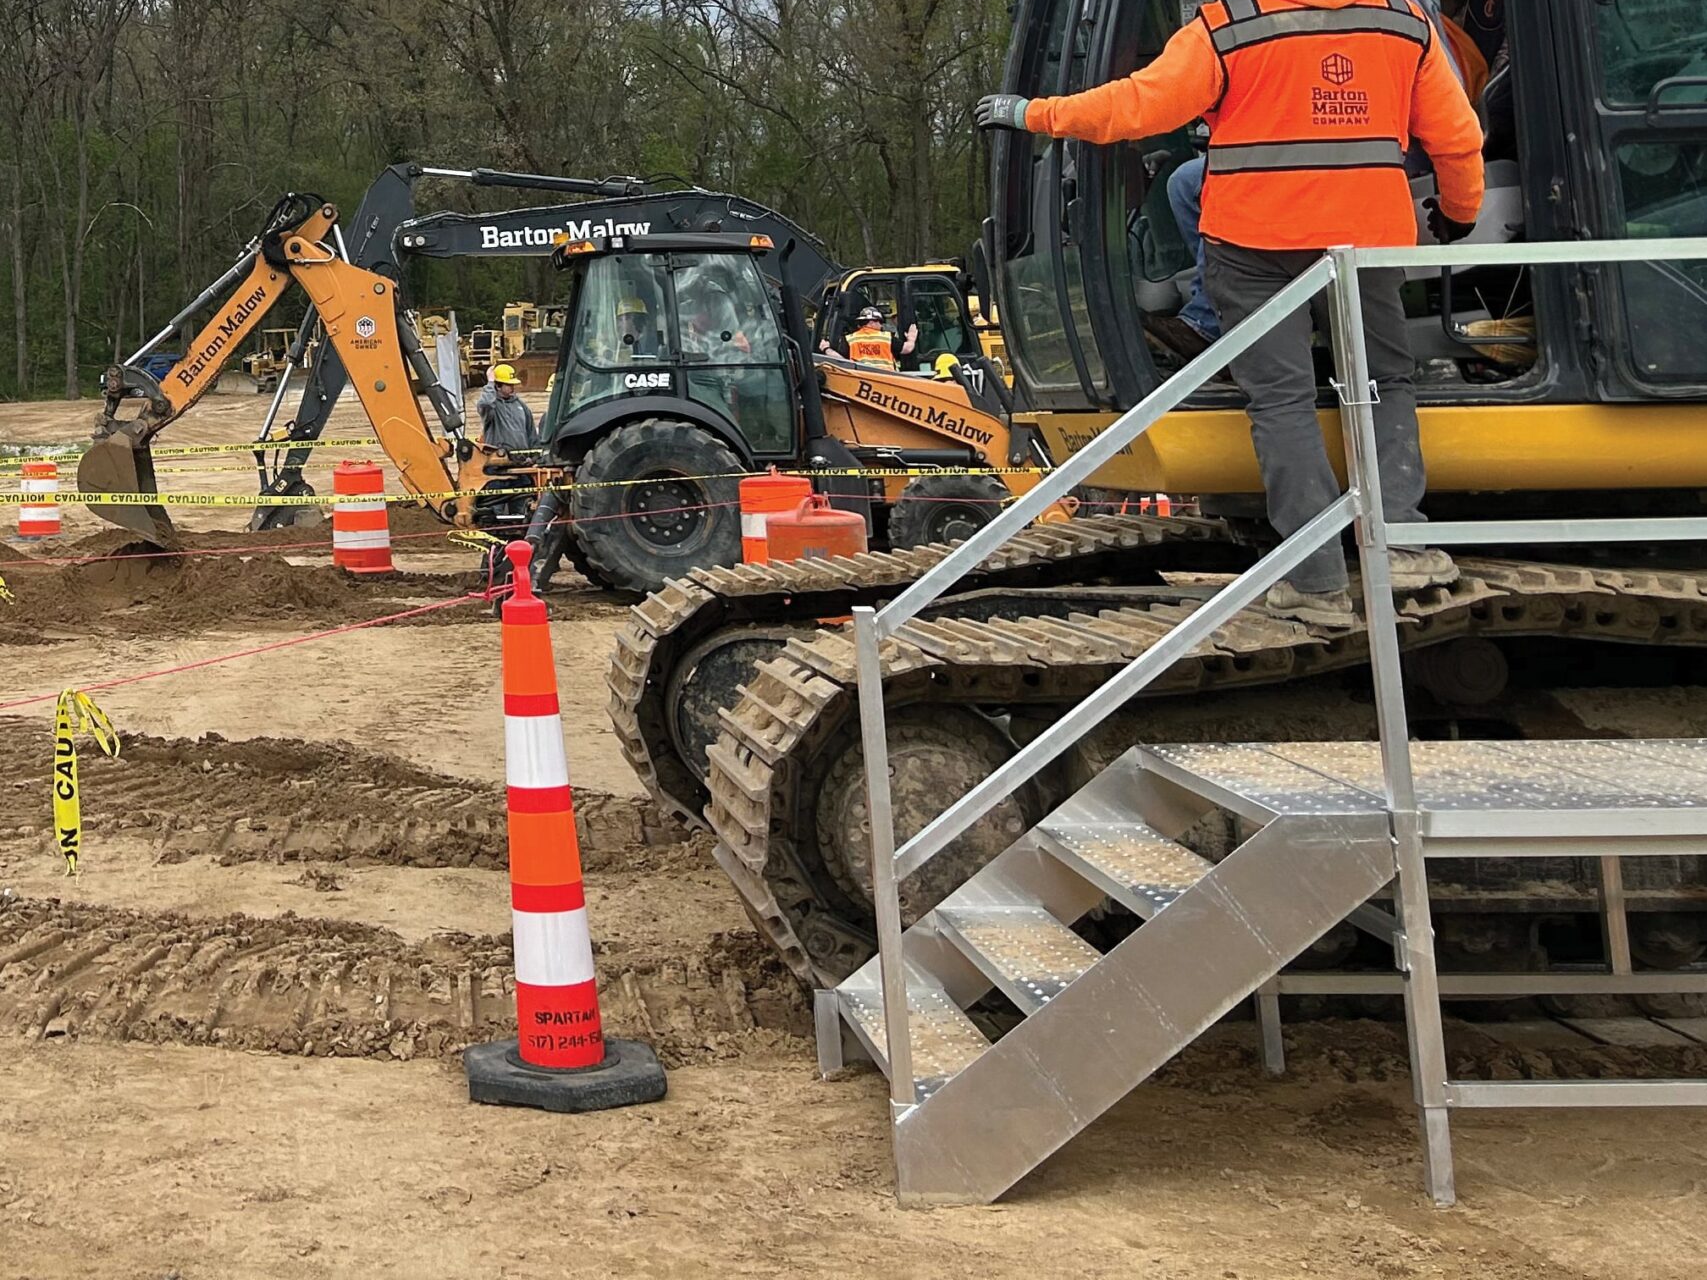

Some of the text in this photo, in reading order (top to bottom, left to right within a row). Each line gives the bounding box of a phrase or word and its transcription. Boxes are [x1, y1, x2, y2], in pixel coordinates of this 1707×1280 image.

[1311, 87, 1368, 101] Barton
[1311, 101, 1368, 115] Malow
[1312, 117, 1370, 125] COMPANY
[176, 286, 267, 388] Barton Malow
[624, 372, 671, 388] CASE
[855, 380, 994, 445] Barton Malow
